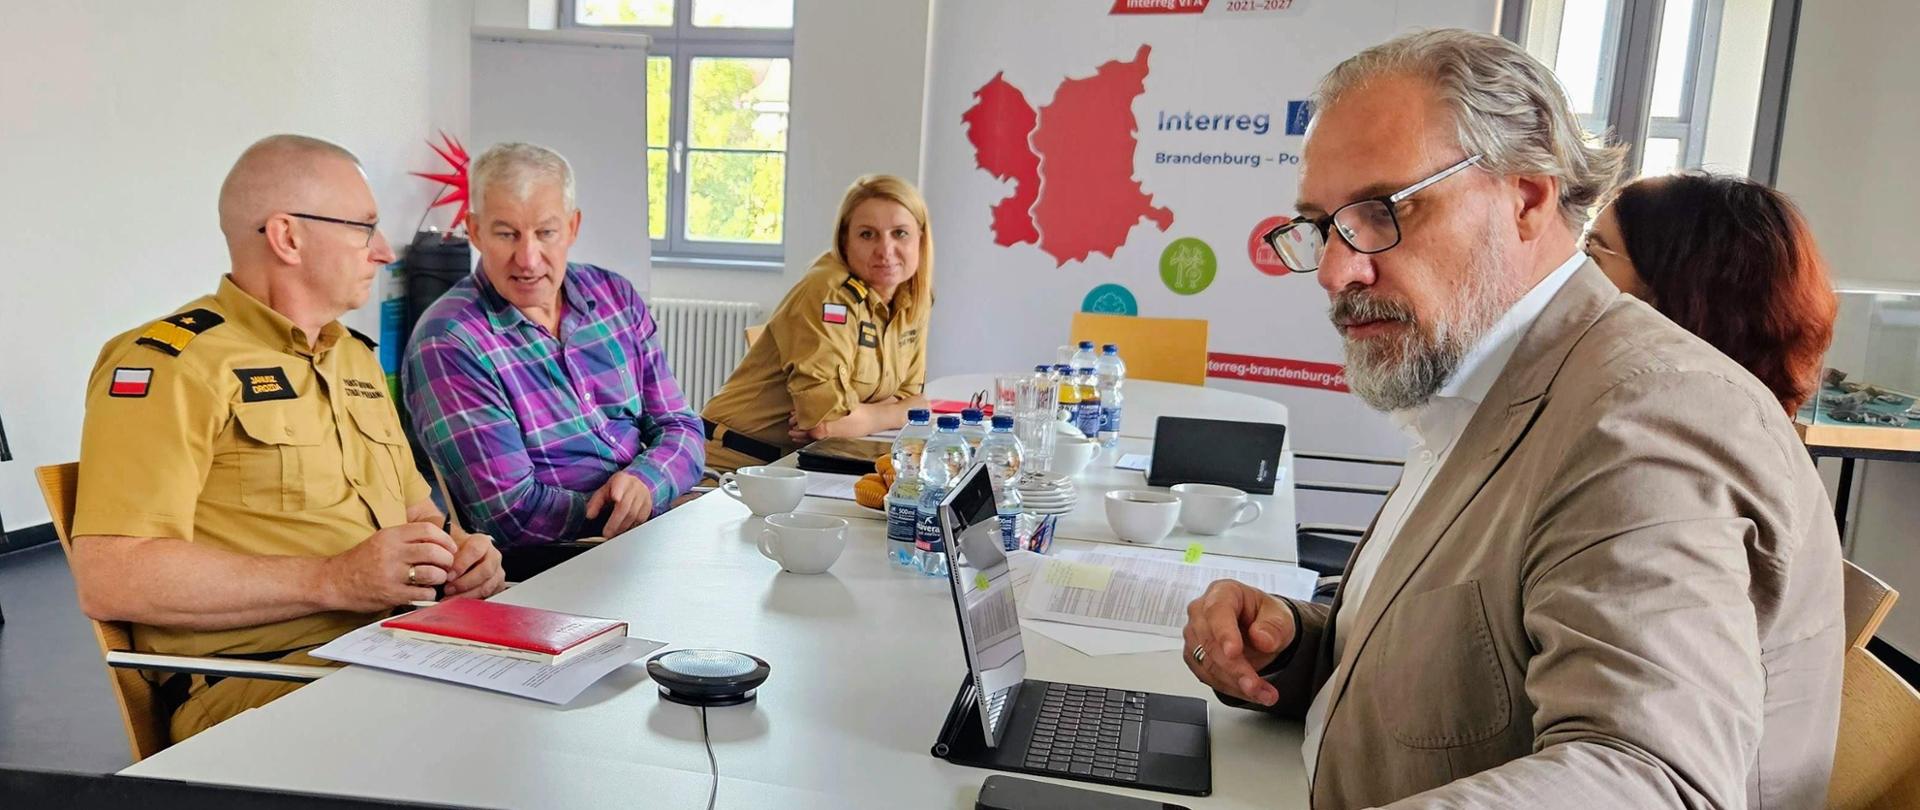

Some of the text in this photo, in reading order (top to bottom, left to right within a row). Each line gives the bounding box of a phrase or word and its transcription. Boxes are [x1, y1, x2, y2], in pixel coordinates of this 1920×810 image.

[1157, 110, 1270, 134] Interreg
[1155, 152, 1261, 167] Brandenburg
[1278, 153, 1299, 164] Po
